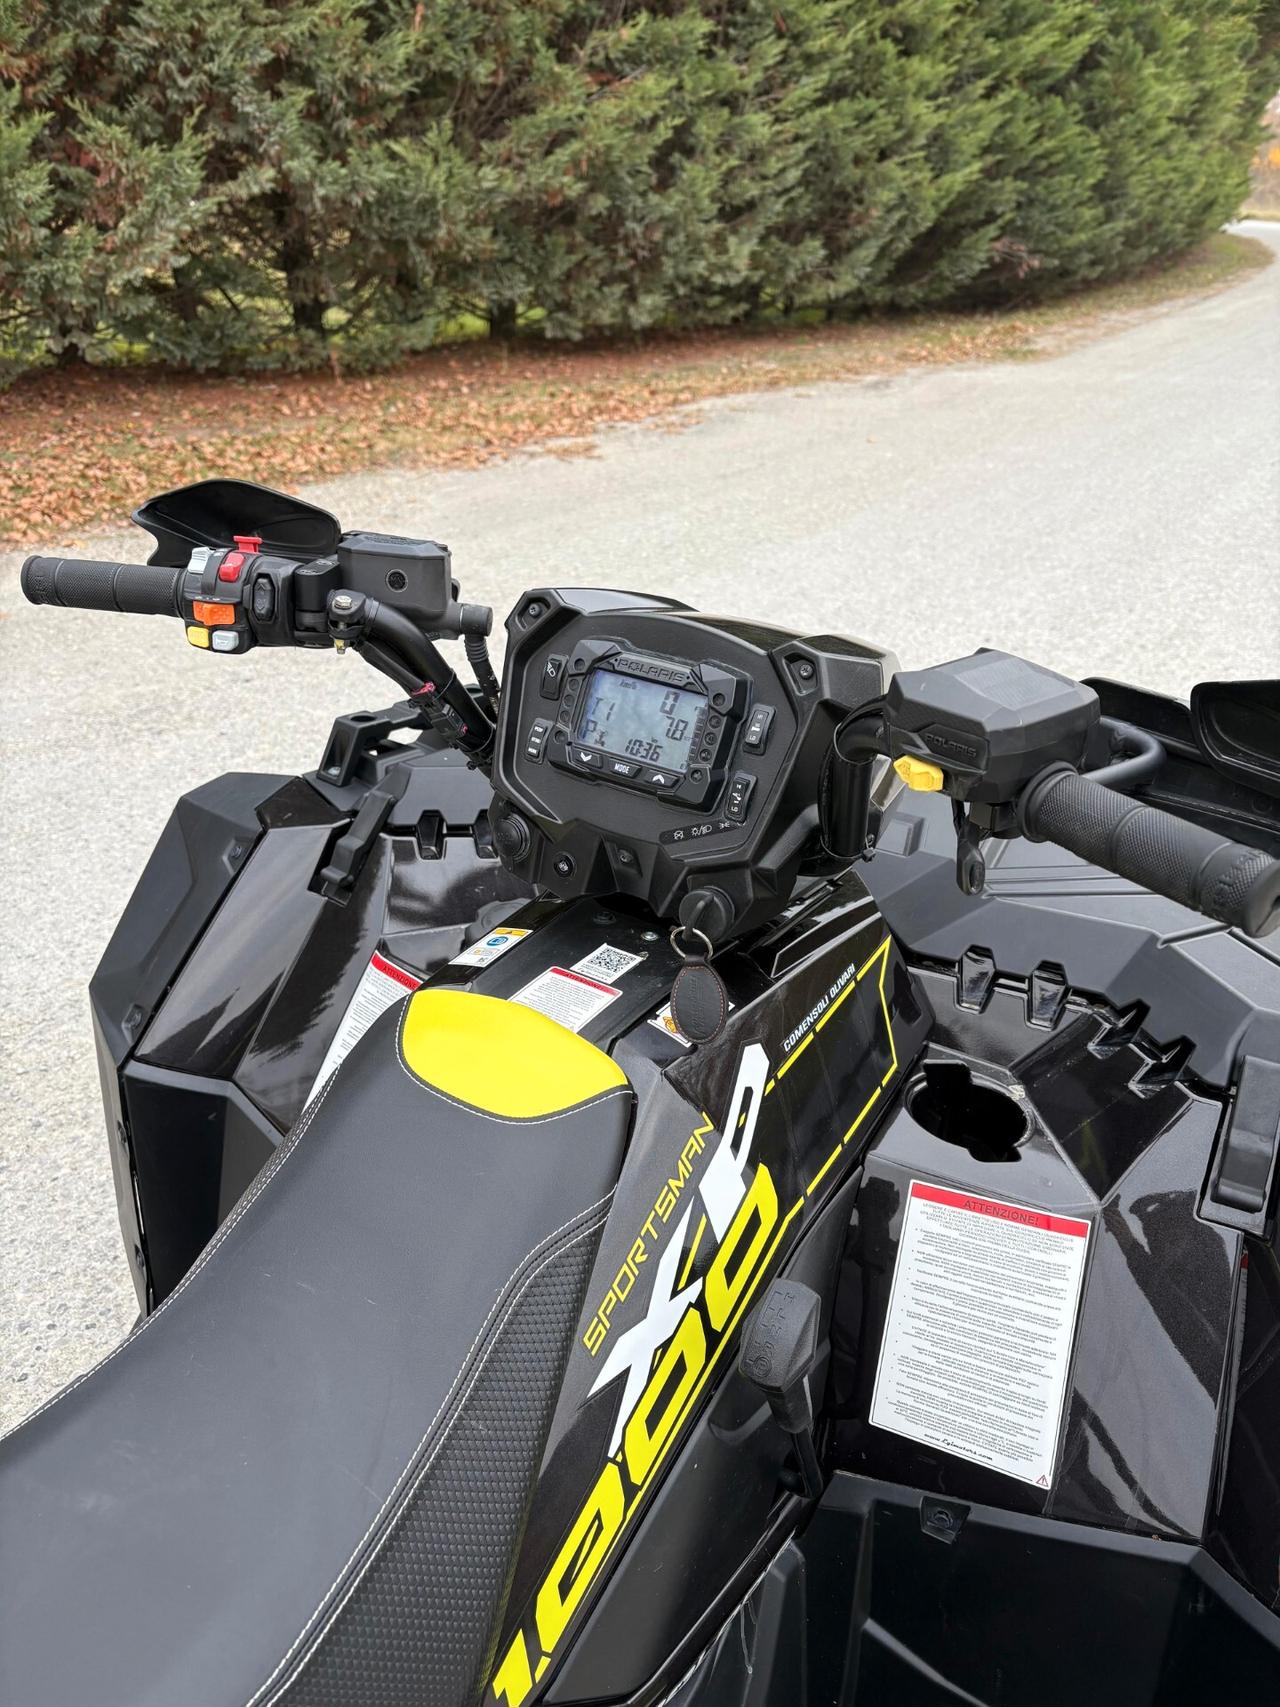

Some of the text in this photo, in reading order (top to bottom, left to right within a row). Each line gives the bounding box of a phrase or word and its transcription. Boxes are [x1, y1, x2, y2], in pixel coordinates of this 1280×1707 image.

[616, 658, 687, 683] POLARIS
[924, 733, 977, 758] POLARIS
[614, 763, 631, 775] MODE
[783, 962, 857, 1053] COMENSOLI OLIVARI
[963, 1198, 1040, 1227] ATTENZIONE!
[583, 1111, 716, 1358] SPORTSMAN
[586, 1043, 770, 1458] XP
